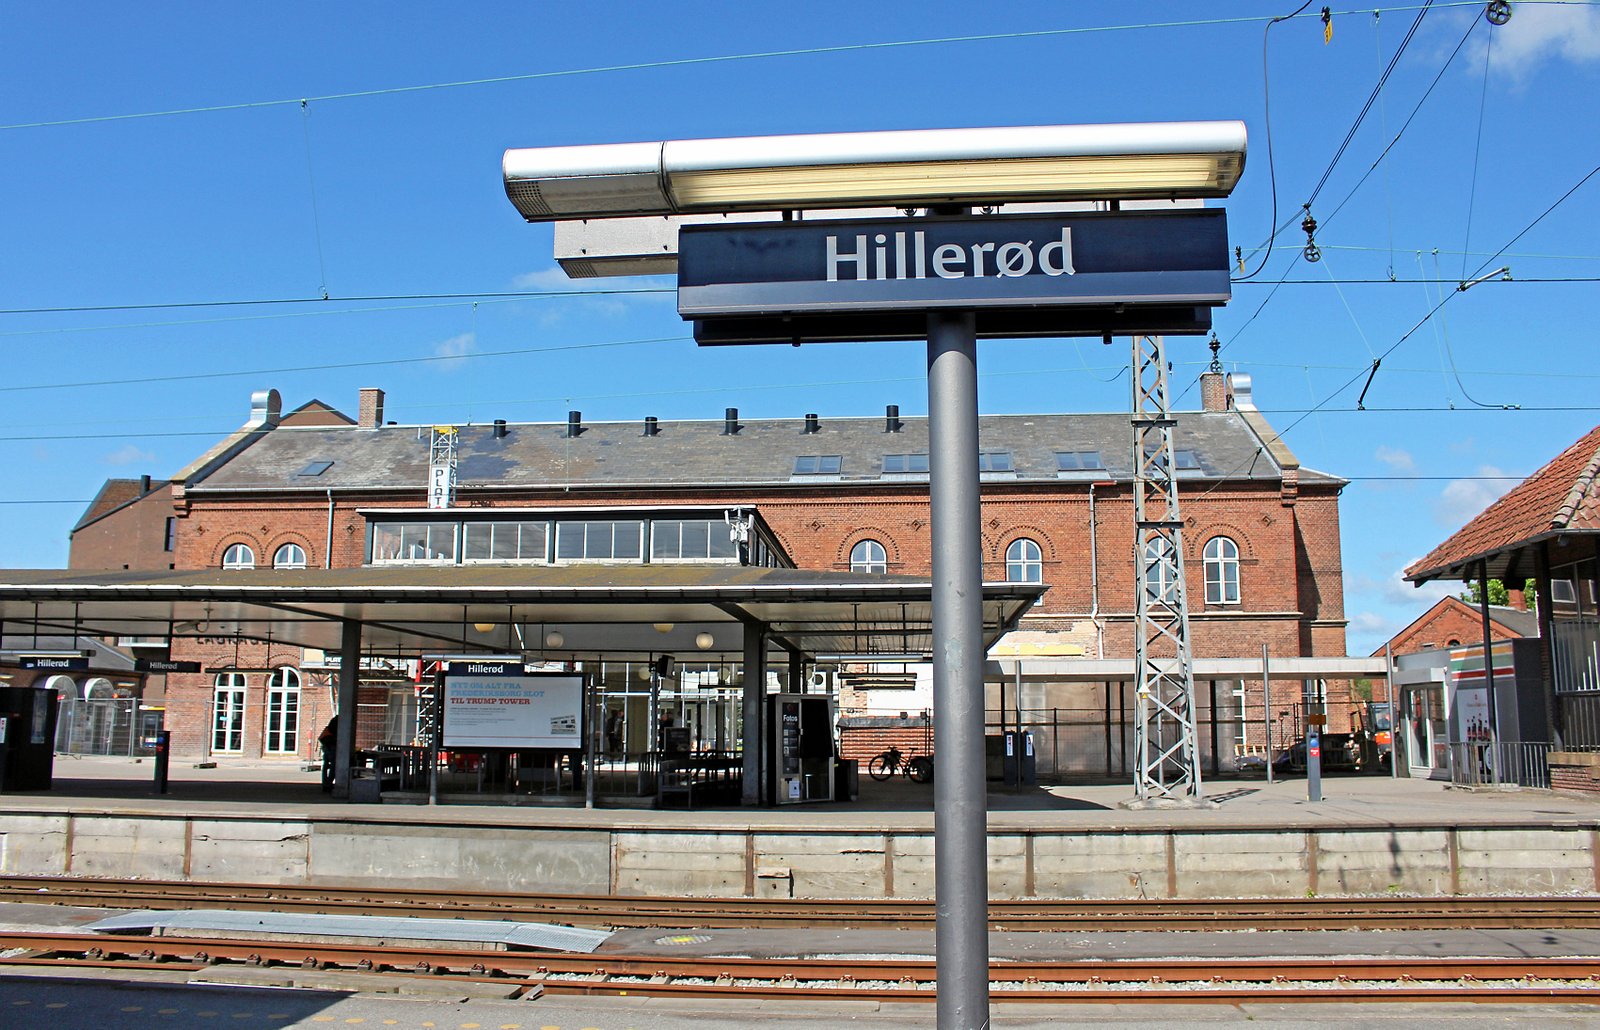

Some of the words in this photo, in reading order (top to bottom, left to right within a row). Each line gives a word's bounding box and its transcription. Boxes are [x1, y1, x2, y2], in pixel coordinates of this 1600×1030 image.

[826, 226, 1076, 282] Hillerød
[37, 658, 69, 667] Hillerød
[150, 661, 178, 670] Hillerød
[468, 664, 504, 673] Hillerød
